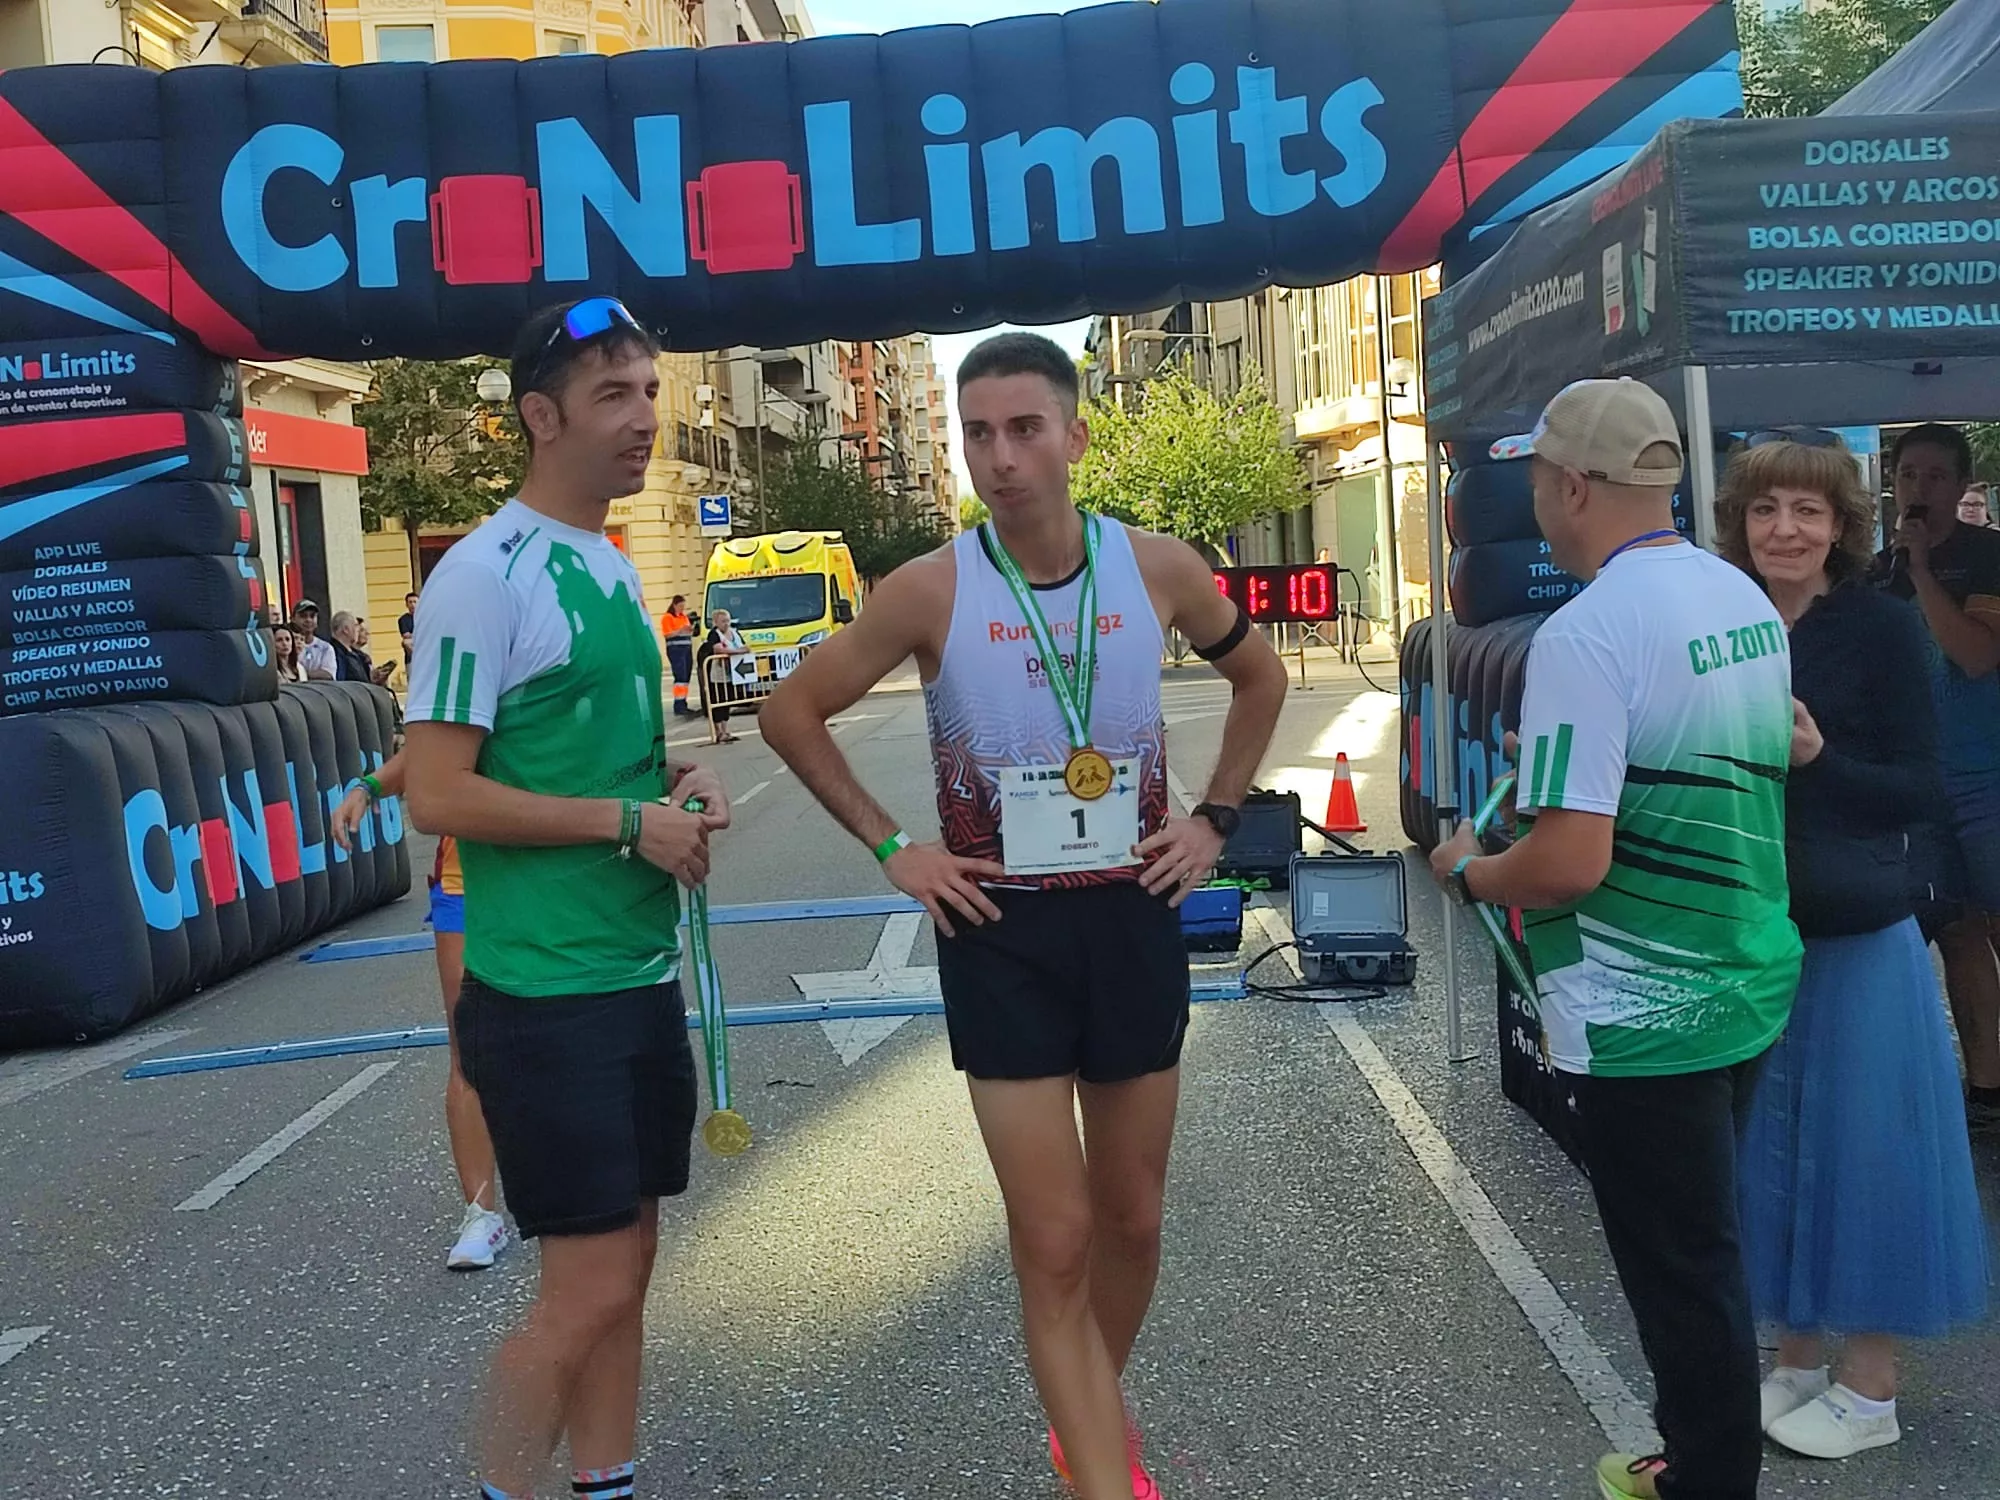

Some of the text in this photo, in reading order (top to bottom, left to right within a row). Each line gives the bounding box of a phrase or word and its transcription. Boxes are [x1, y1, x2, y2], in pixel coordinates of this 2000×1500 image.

[1804, 136, 1950, 166] DORSALES
[1759, 175, 1999, 208] VALLAS Y ARCOS
[1748, 225, 1844, 250] BOLSA
[1744, 260, 2000, 292] SPEAKER Y SONID
[1727, 307, 1857, 333] TROFEOS
[1860, 306, 1881, 329] Y
[13, 388, 28, 399] de
[29, 383, 102, 398] cronometraje
[103, 384, 112, 395] y
[10, 402, 25, 413] de
[26, 400, 69, 412] eventos
[70, 396, 127, 409] deportivos
[34, 542, 101, 560] APP LIVE
[34, 561, 108, 578] DORSALES
[12, 578, 131, 602] VÍDEO RESUMEN
[1528, 584, 1567, 599] CHIP
[13, 599, 135, 623] VALLAS Y ARCOS
[12, 620, 148, 645] BOLSA CORREDOR
[12, 636, 150, 663] SPEAKER Y SONIDO
[776, 652, 800, 671] 10K
[1688, 633, 1729, 676] C.D.
[3, 656, 163, 686] TROFEOS Y MEDALLAS
[5, 676, 169, 708] CHIP ACTIVO Y PASIVO
[1070, 808, 1086, 838] 1
[1, 916, 12, 930] y
